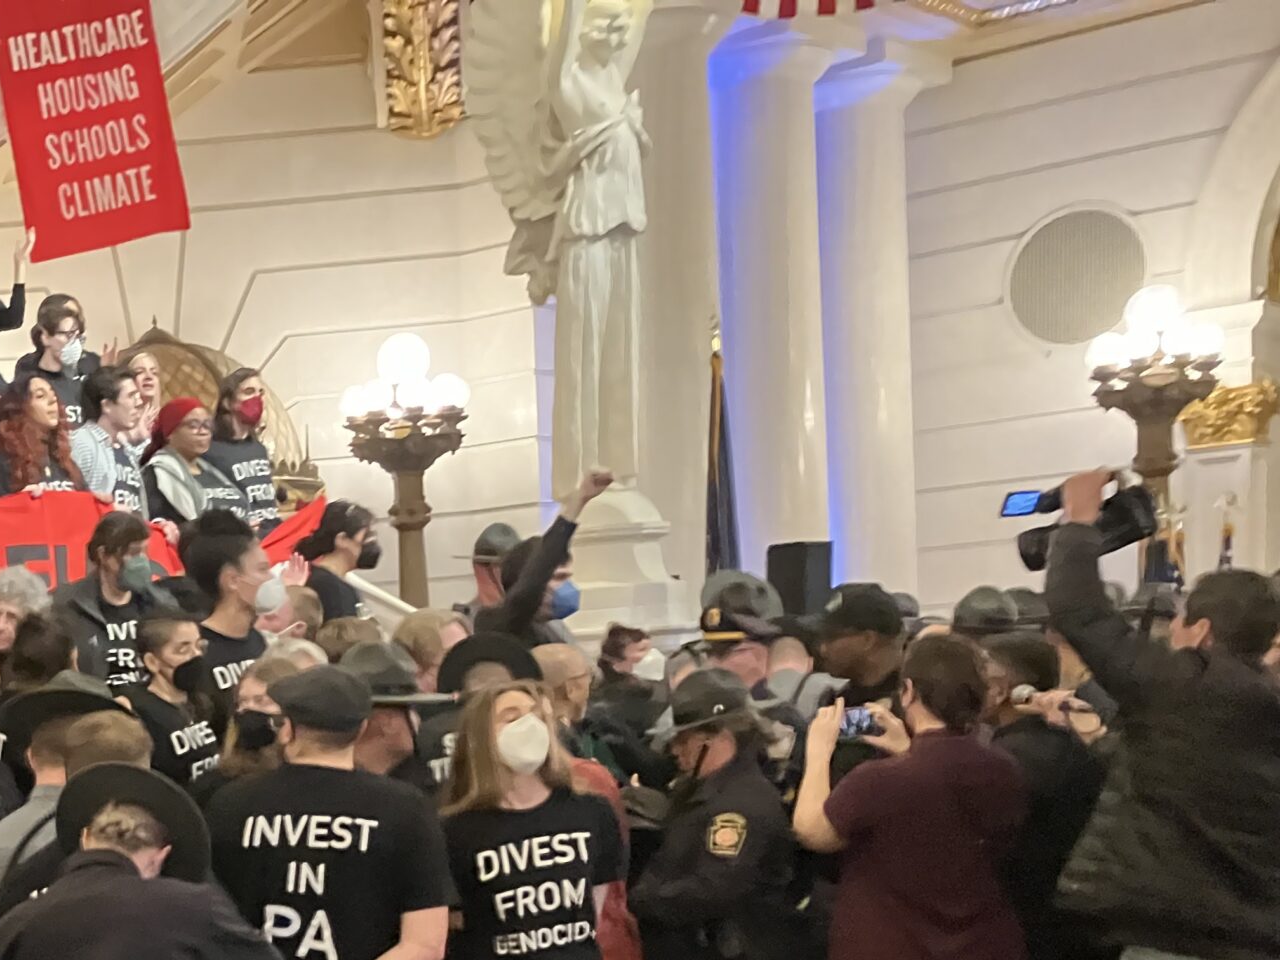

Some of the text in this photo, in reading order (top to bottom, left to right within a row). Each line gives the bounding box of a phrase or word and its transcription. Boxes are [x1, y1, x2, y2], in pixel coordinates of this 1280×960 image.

[8, 9, 149, 72] HEALTHCARE
[37, 63, 140, 120] HOUSING
[45, 113, 151, 170] SCHOOLS
[58, 164, 157, 220] CLIMATE
[242, 814, 379, 852] INVEST
[476, 831, 591, 882] DIVEST
[286, 860, 325, 895] IN
[494, 877, 586, 921] FROM
[494, 921, 597, 955] GENOCID
